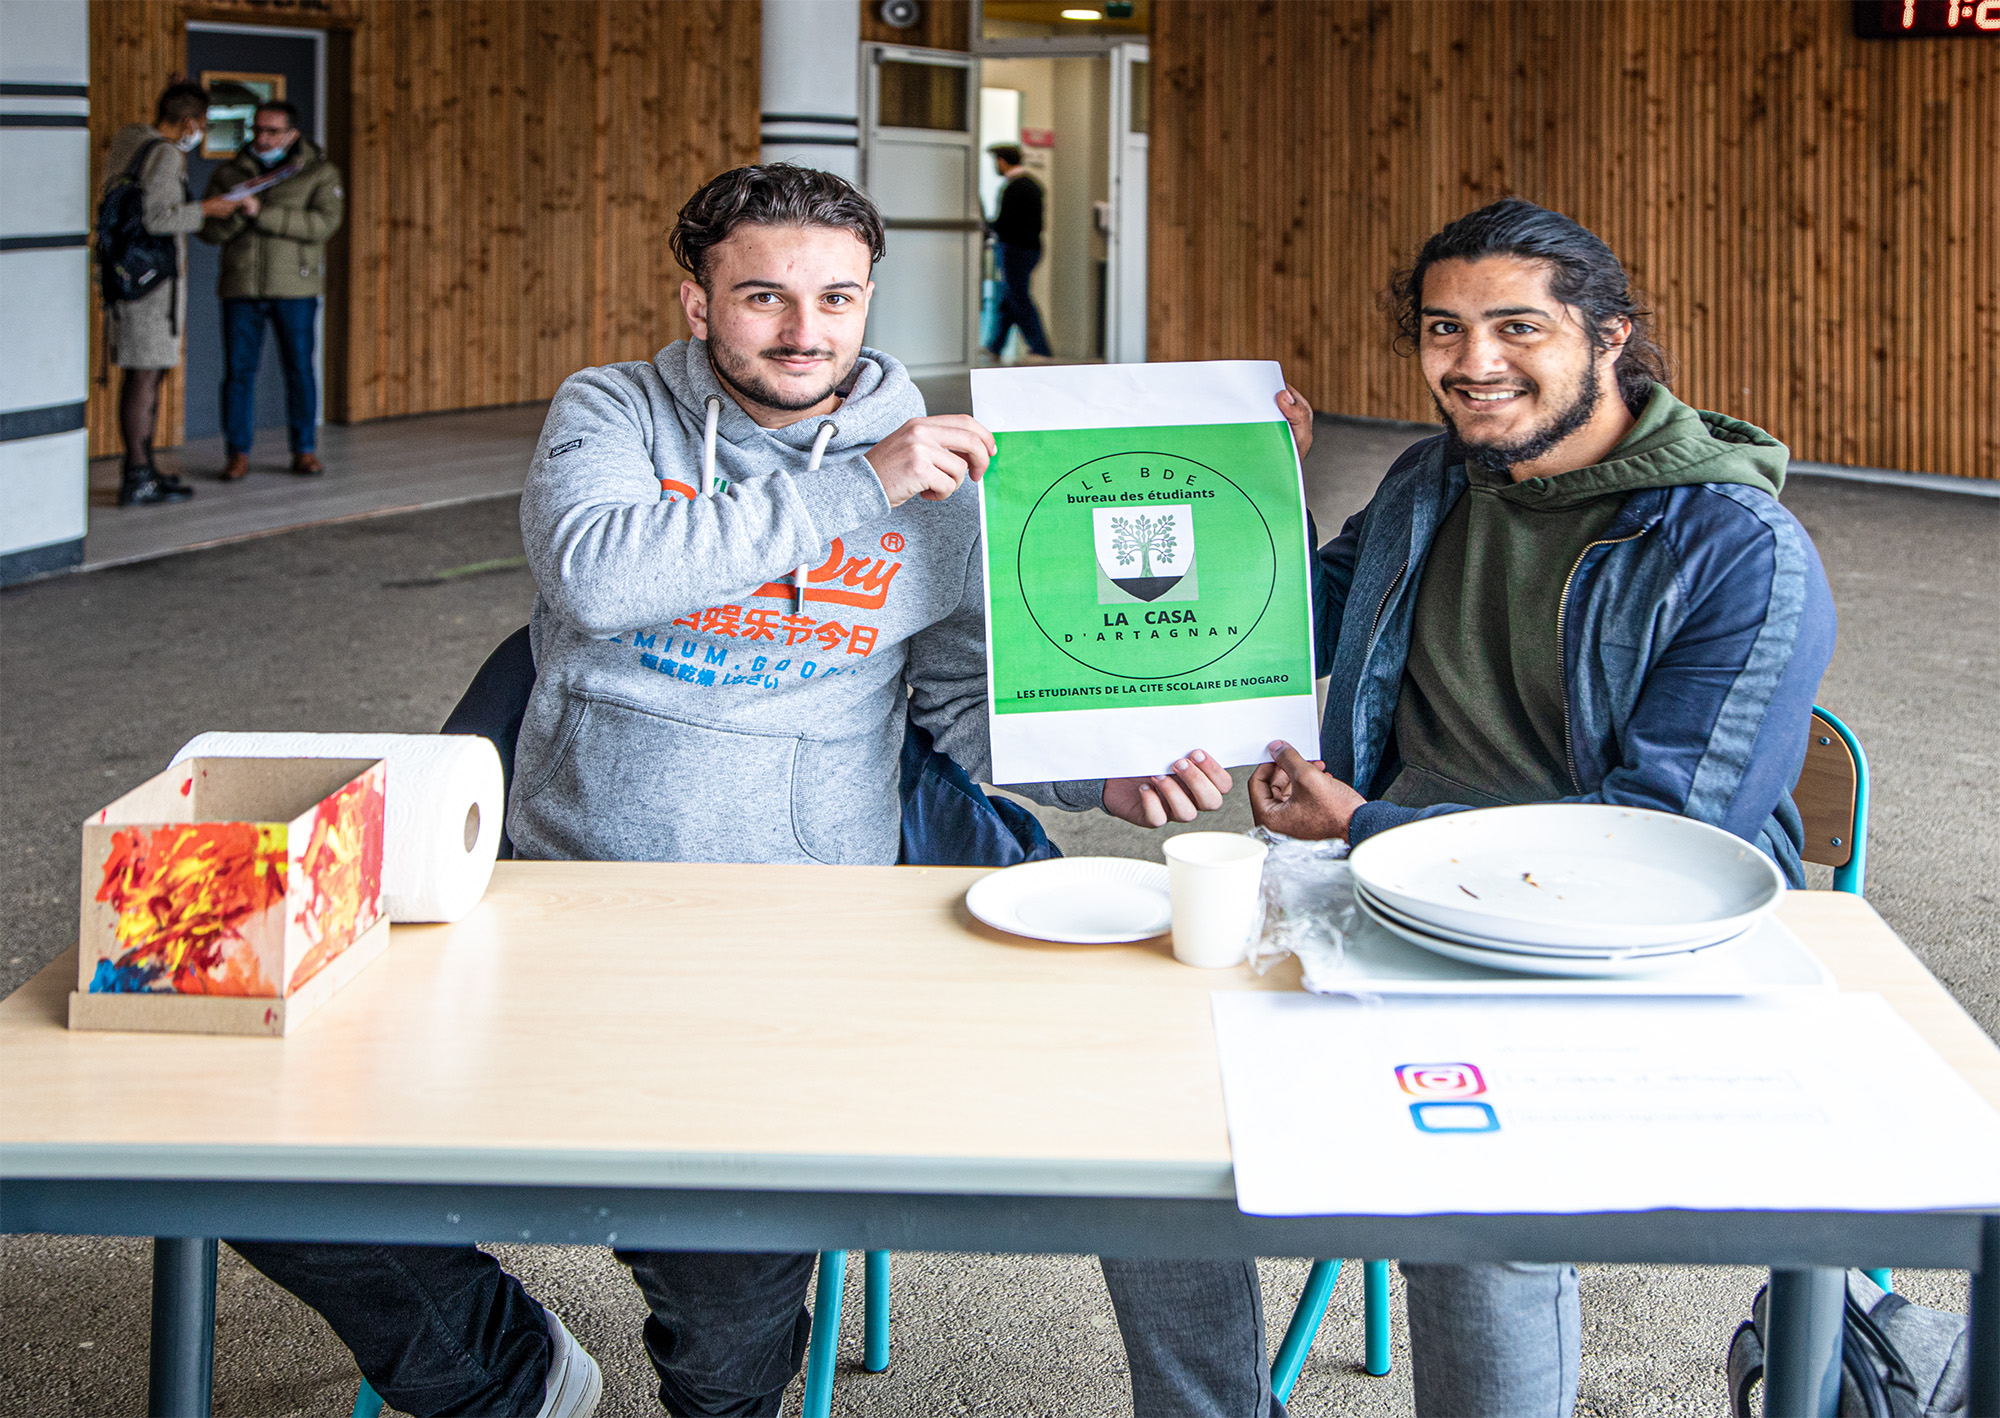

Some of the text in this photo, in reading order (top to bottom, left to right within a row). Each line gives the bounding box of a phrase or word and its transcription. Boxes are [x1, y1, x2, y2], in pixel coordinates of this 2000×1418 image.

[1081, 467, 1197, 490] LE BDE
[1067, 488, 1215, 503] bureau des étudiants
[1103, 609, 1197, 627] LA CASA
[1065, 626, 1238, 643] D'ARTAGNAN
[1016, 674, 1289, 699] LES ETUDIANTS DE LA CITE SCOLAIRE DE NOGARO
